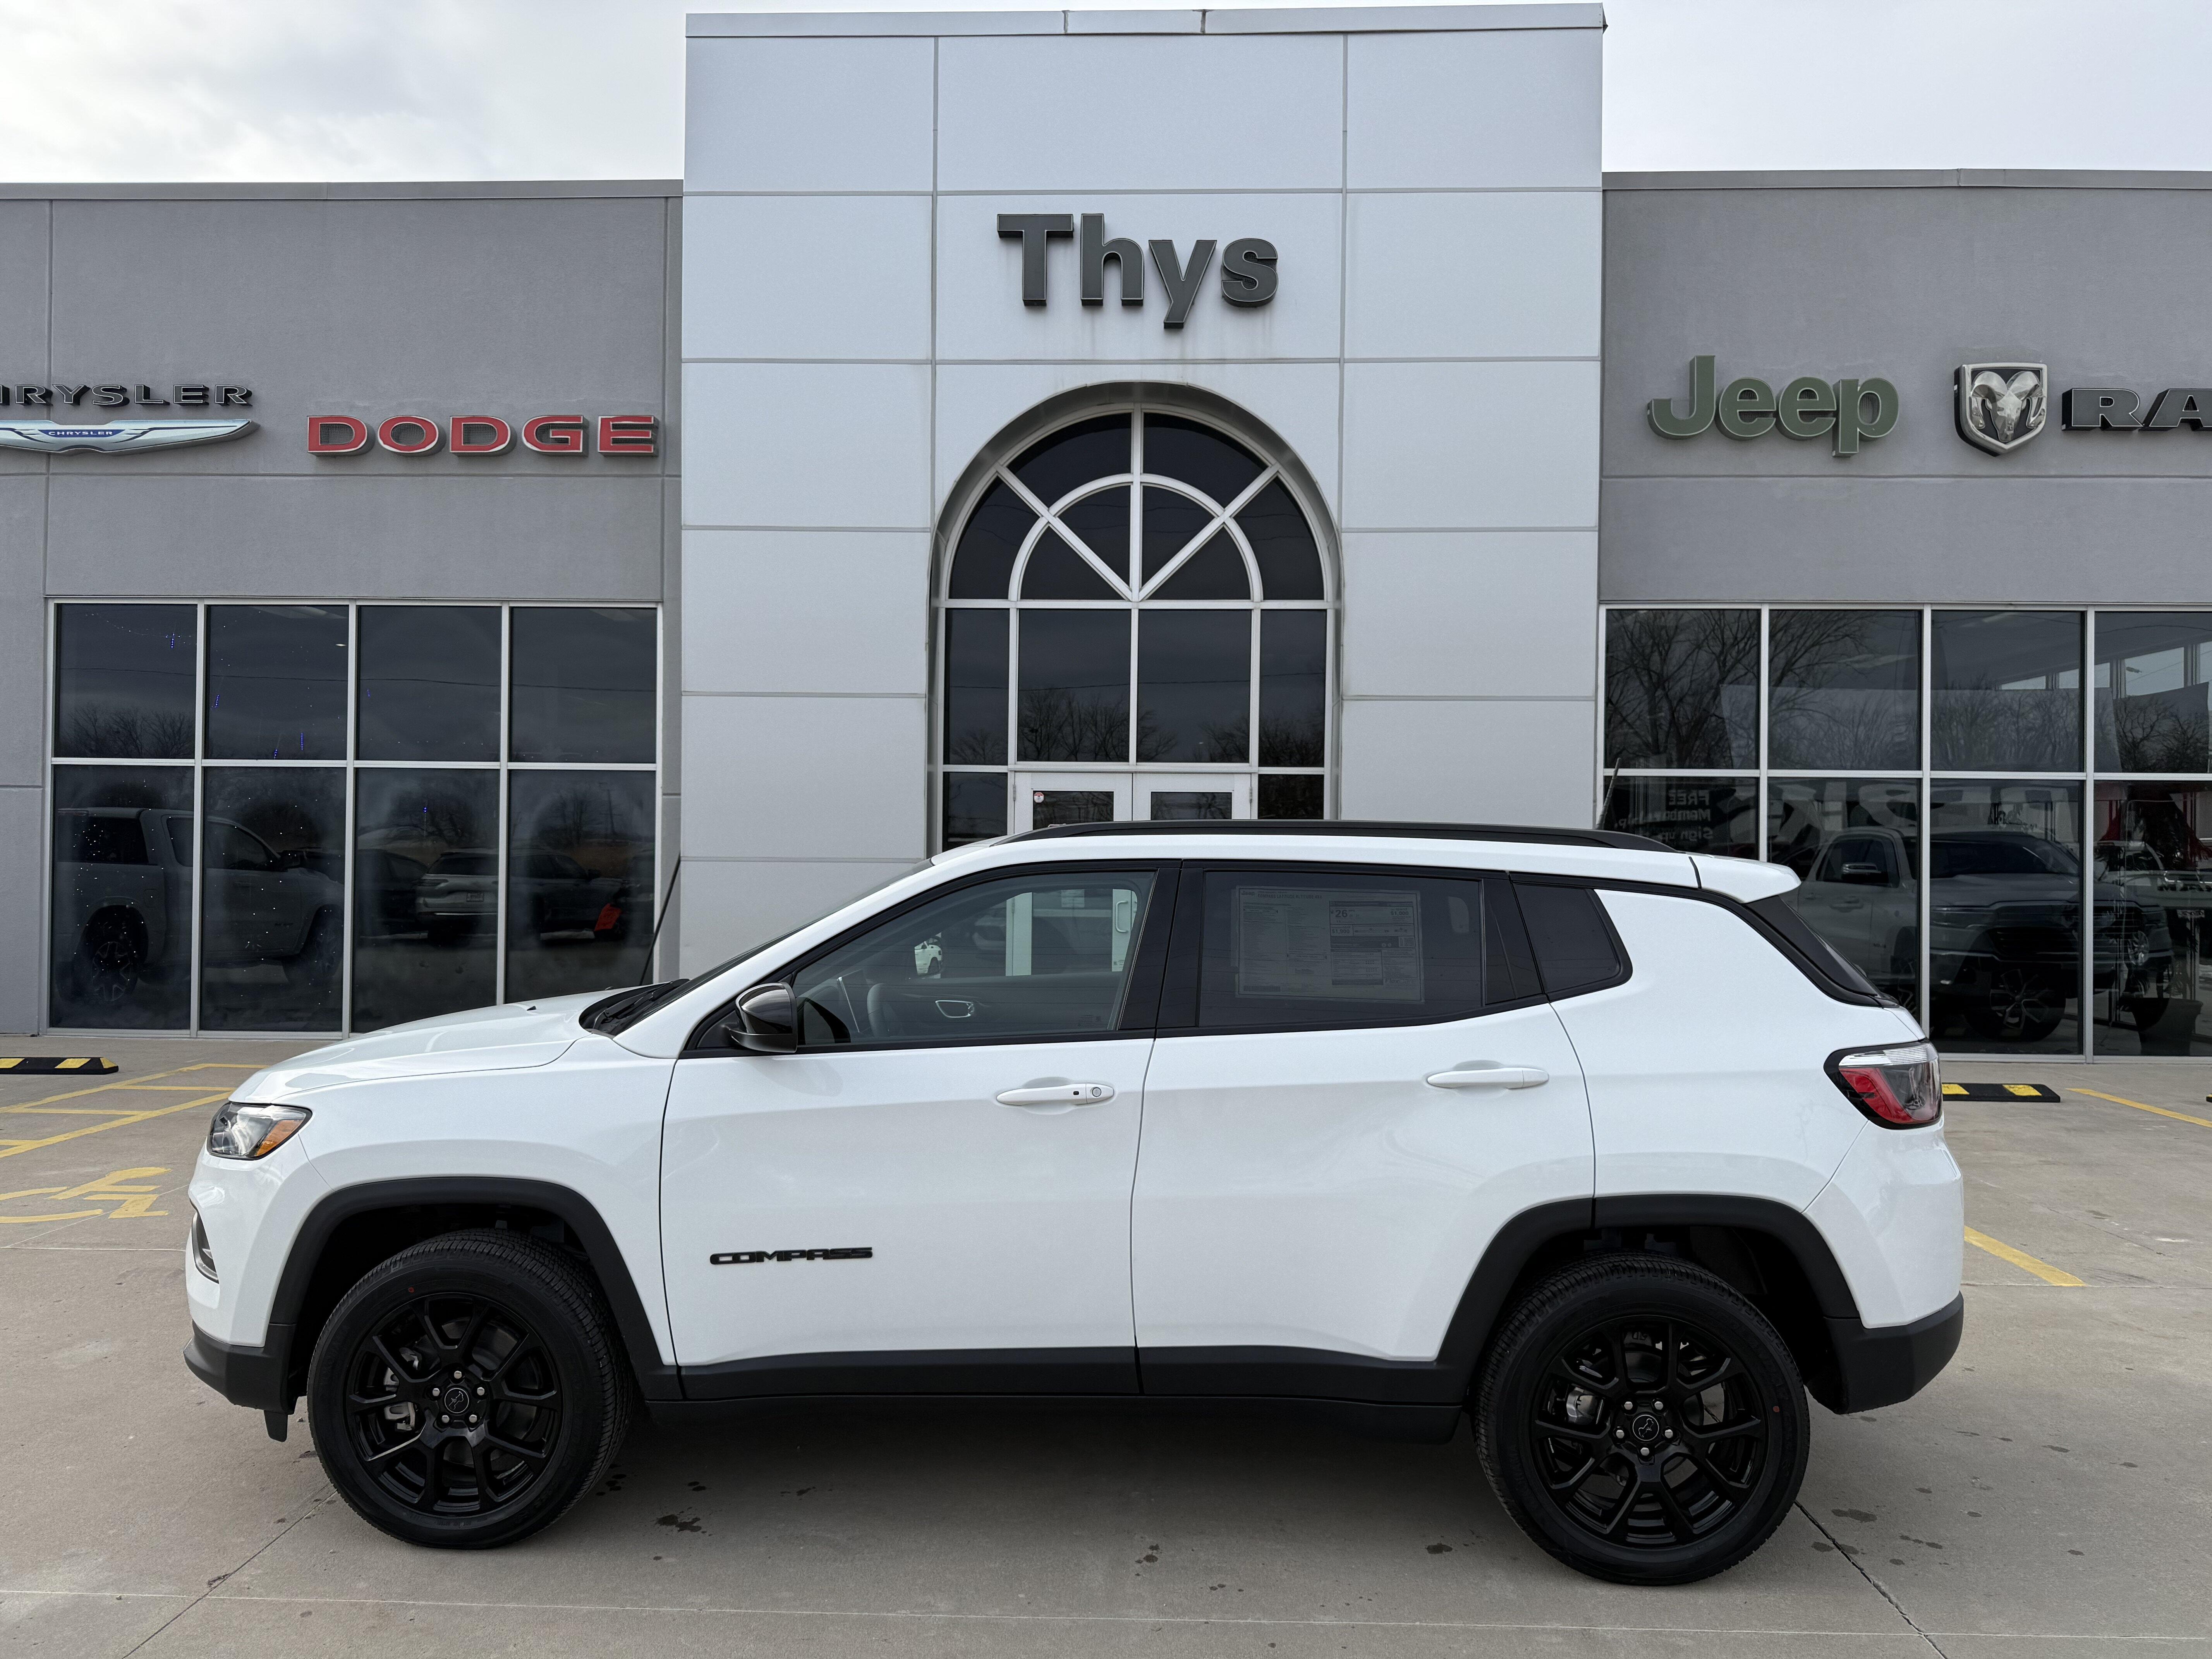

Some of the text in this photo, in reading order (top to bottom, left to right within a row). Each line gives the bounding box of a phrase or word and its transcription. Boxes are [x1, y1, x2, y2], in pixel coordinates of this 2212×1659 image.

[997, 213, 1278, 328] Thys
[0, 385, 252, 405] RYSLER
[1647, 355, 1899, 457] Jeep
[307, 416, 659, 457] DODGE
[710, 1247, 872, 1264] COMPASS
